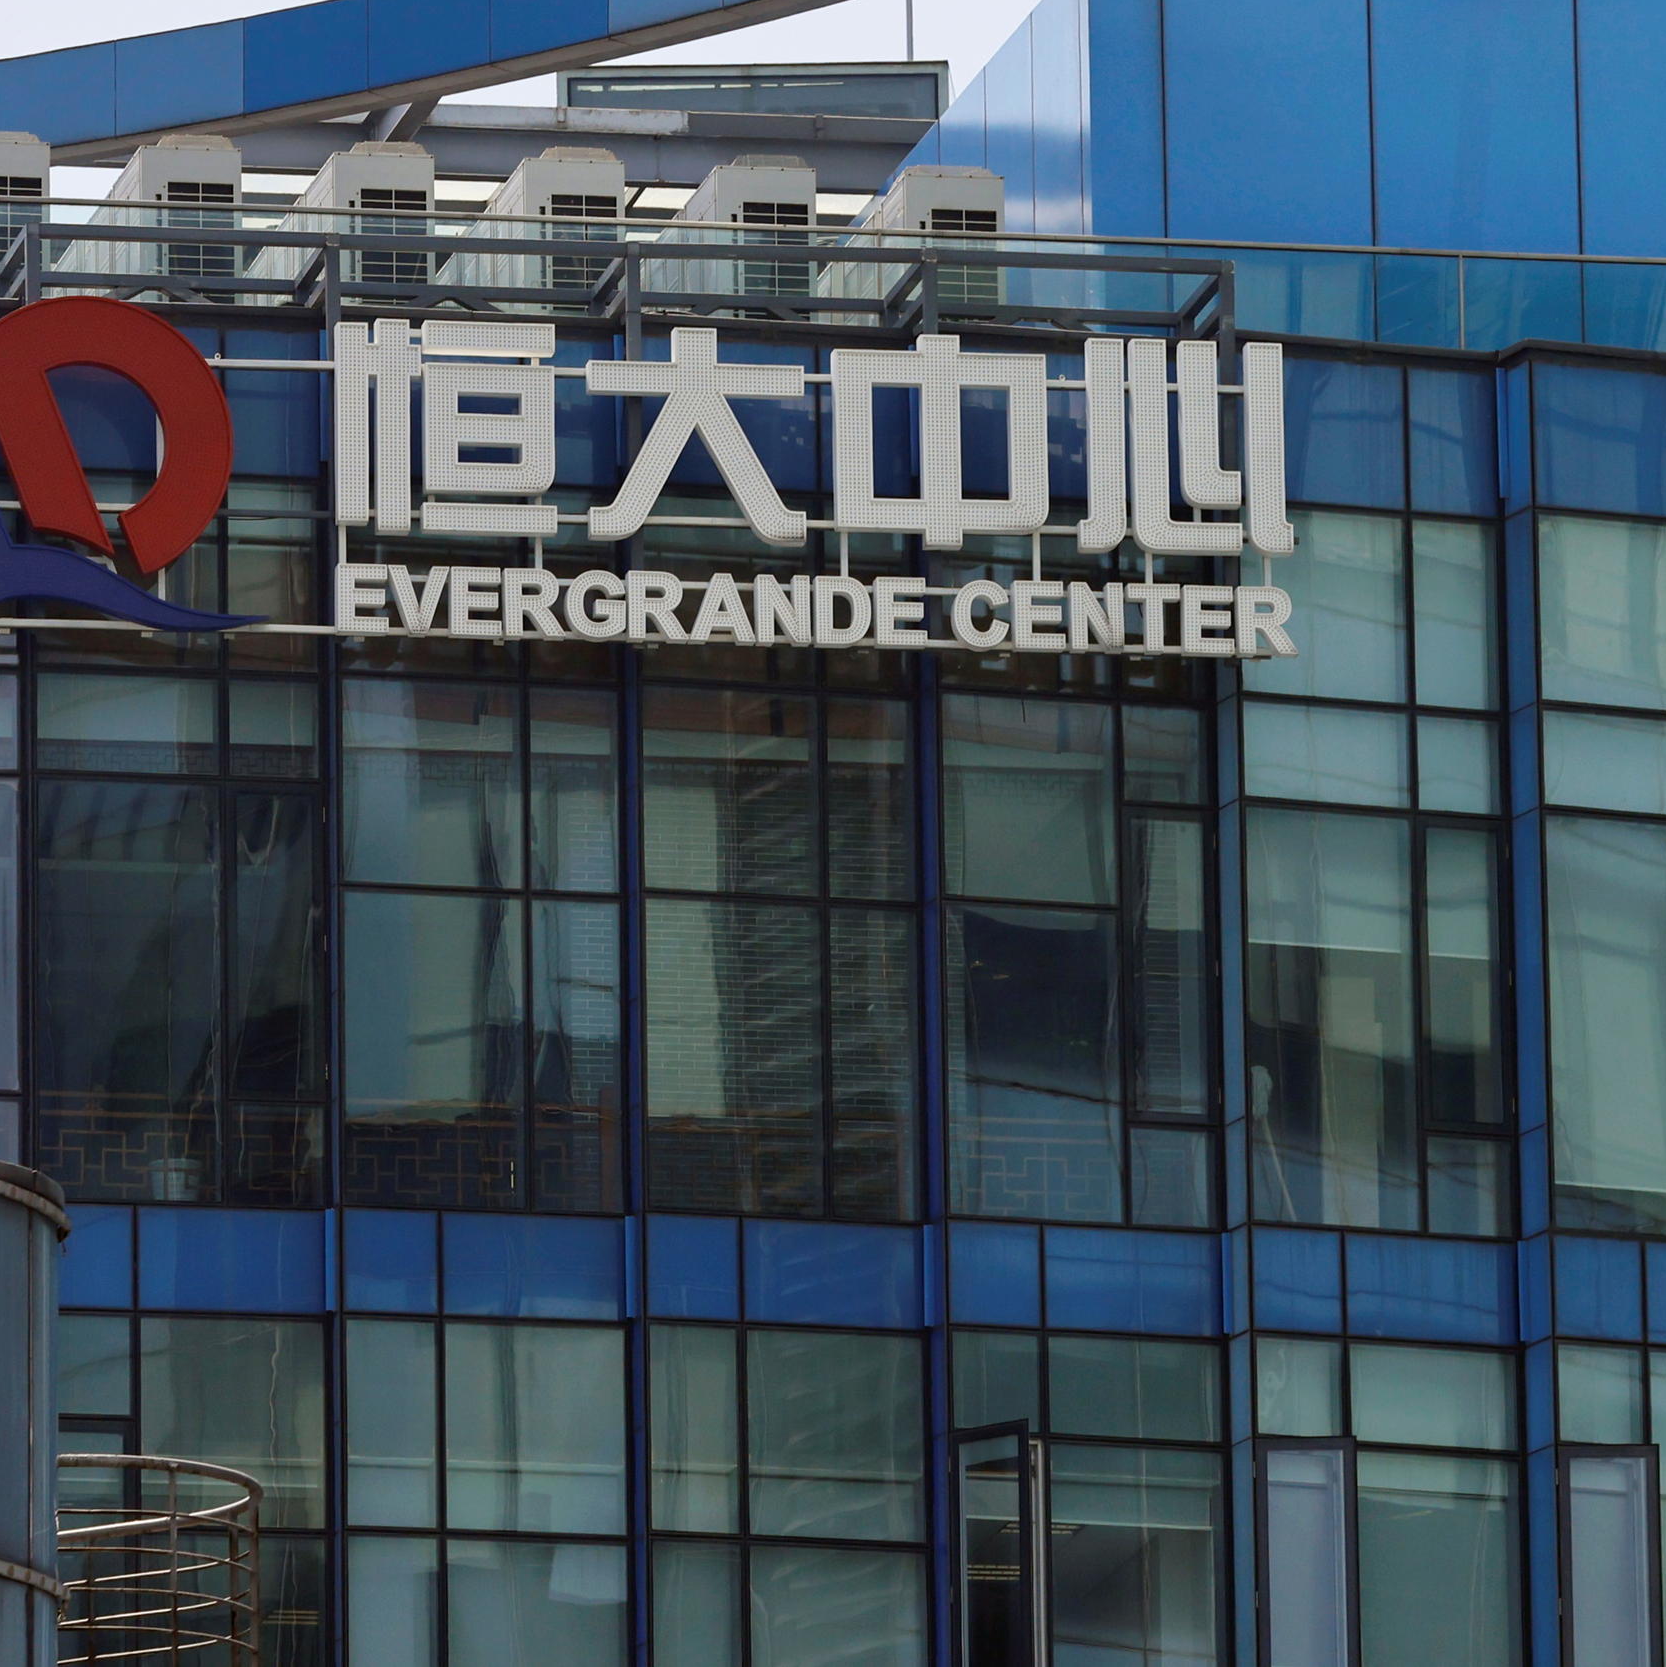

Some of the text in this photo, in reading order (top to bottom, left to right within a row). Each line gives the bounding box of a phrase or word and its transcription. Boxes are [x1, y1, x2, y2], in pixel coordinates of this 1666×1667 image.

[334, 318, 1294, 554] 恒大中心
[334, 563, 1299, 657] EVERGRANDE CENTER
